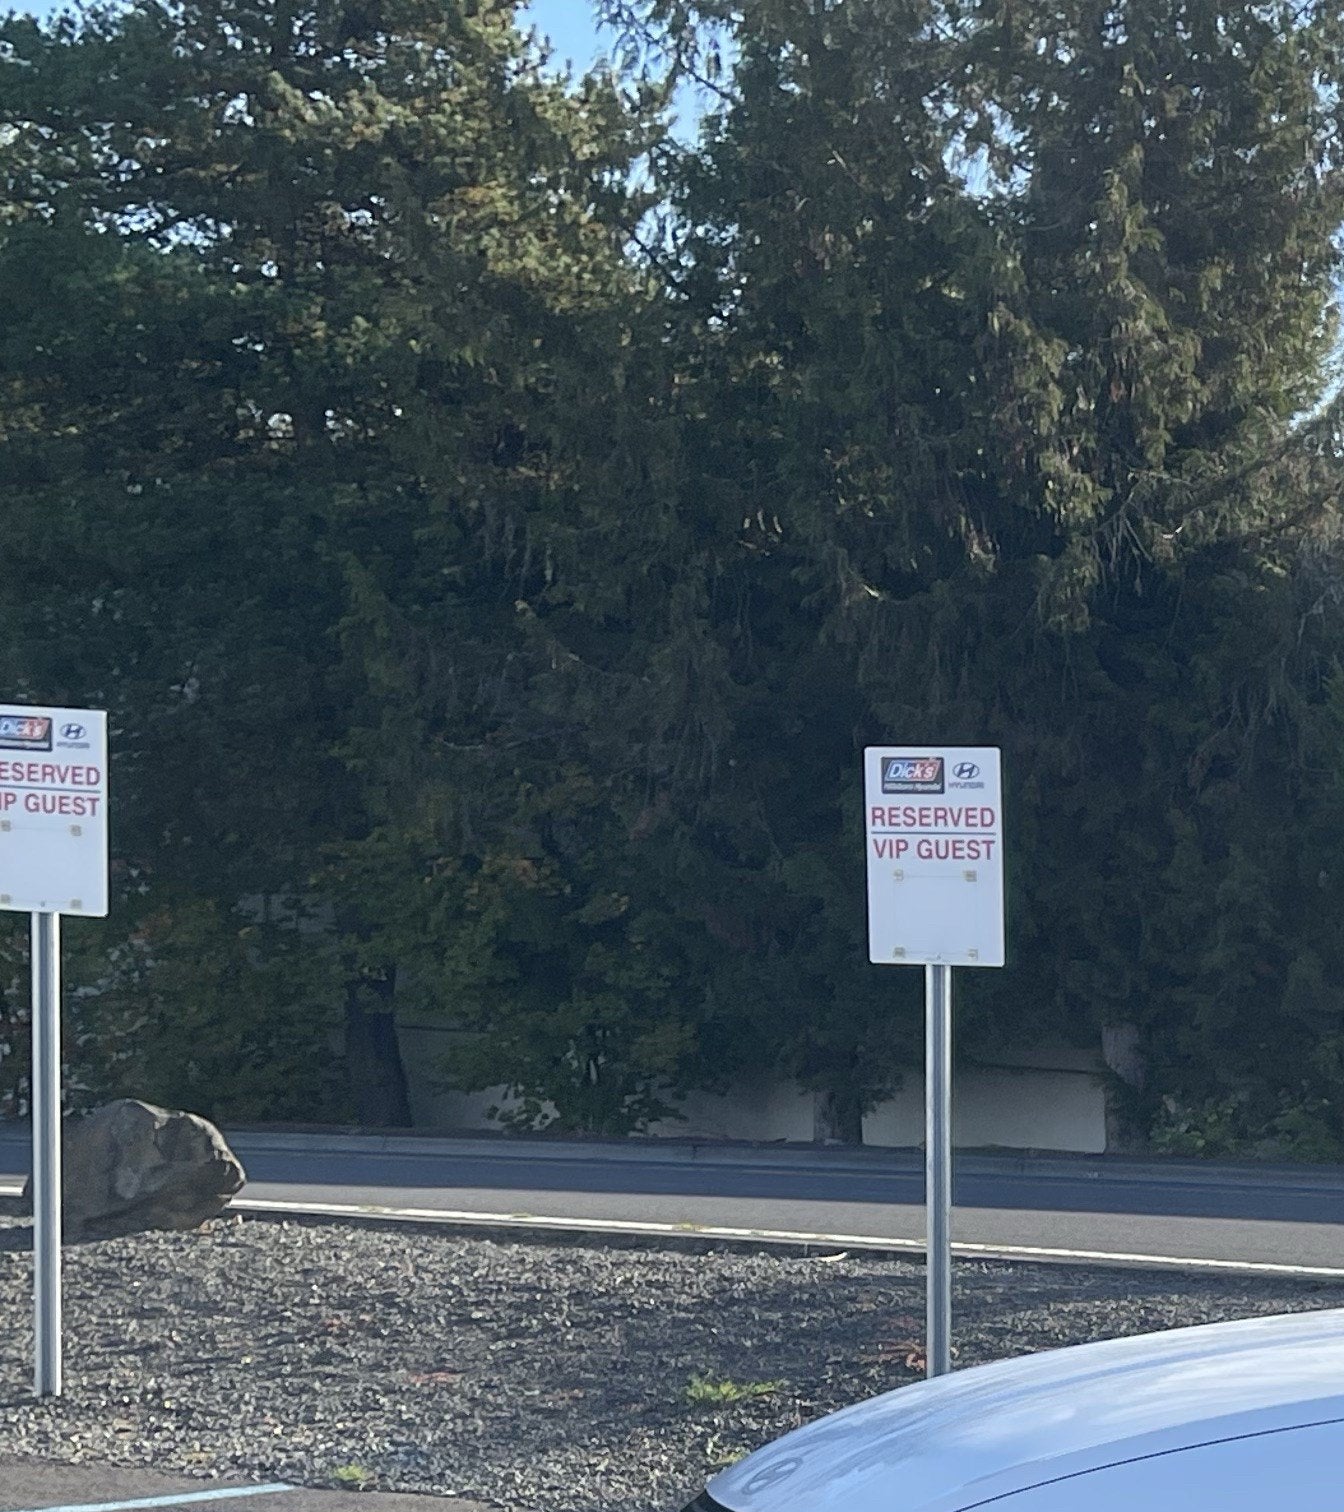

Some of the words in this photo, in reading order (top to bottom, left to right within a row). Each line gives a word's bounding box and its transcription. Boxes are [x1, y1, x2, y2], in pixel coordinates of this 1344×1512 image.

[0, 761, 100, 786] ESERVED
[24, 792, 100, 817] GUEST
[871, 806, 995, 828] RESERVED
[873, 838, 909, 859] VIP
[917, 838, 996, 860] GUEST
